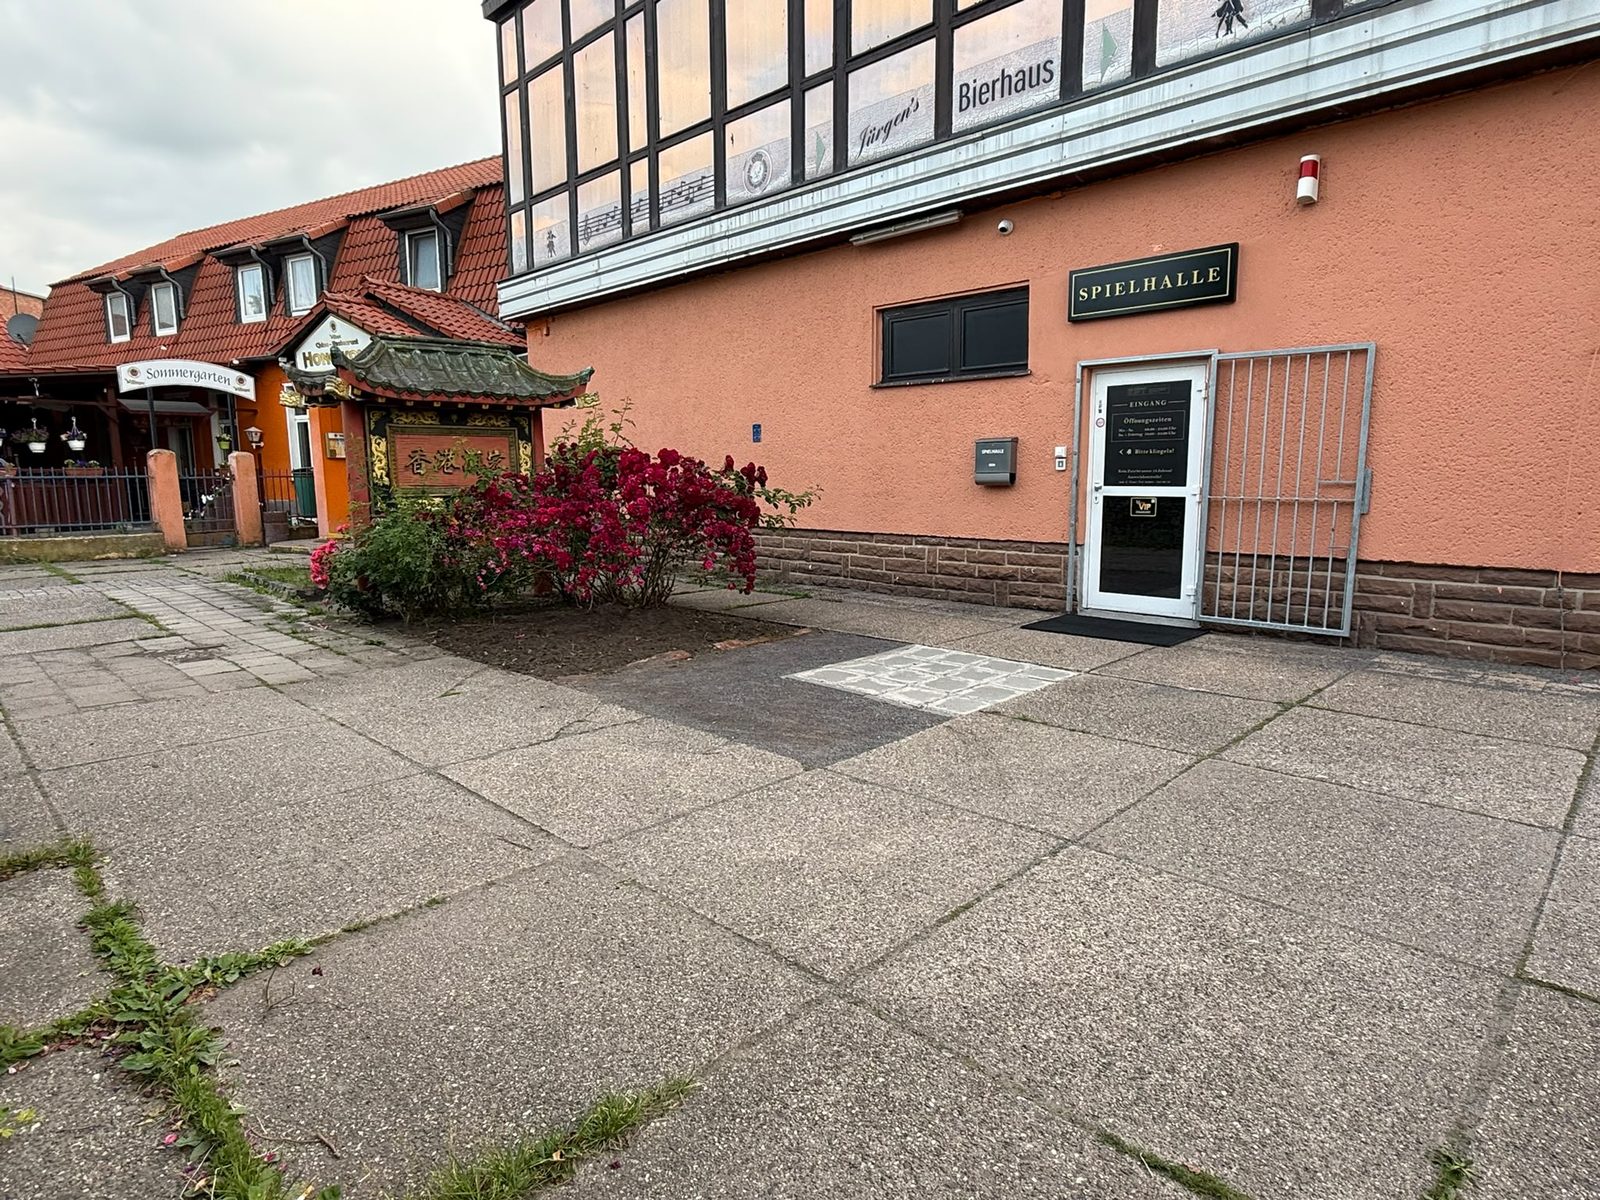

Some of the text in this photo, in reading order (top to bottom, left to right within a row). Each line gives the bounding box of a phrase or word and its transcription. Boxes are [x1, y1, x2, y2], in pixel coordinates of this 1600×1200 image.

[854, 59, 1055, 160] Jürgen's Bierhaus
[1079, 266, 1221, 301] SPIELHALLE
[146, 367, 231, 386] Sommergarten
[1129, 399, 1167, 408] EINGANG
[1138, 501, 1152, 511] VIP
